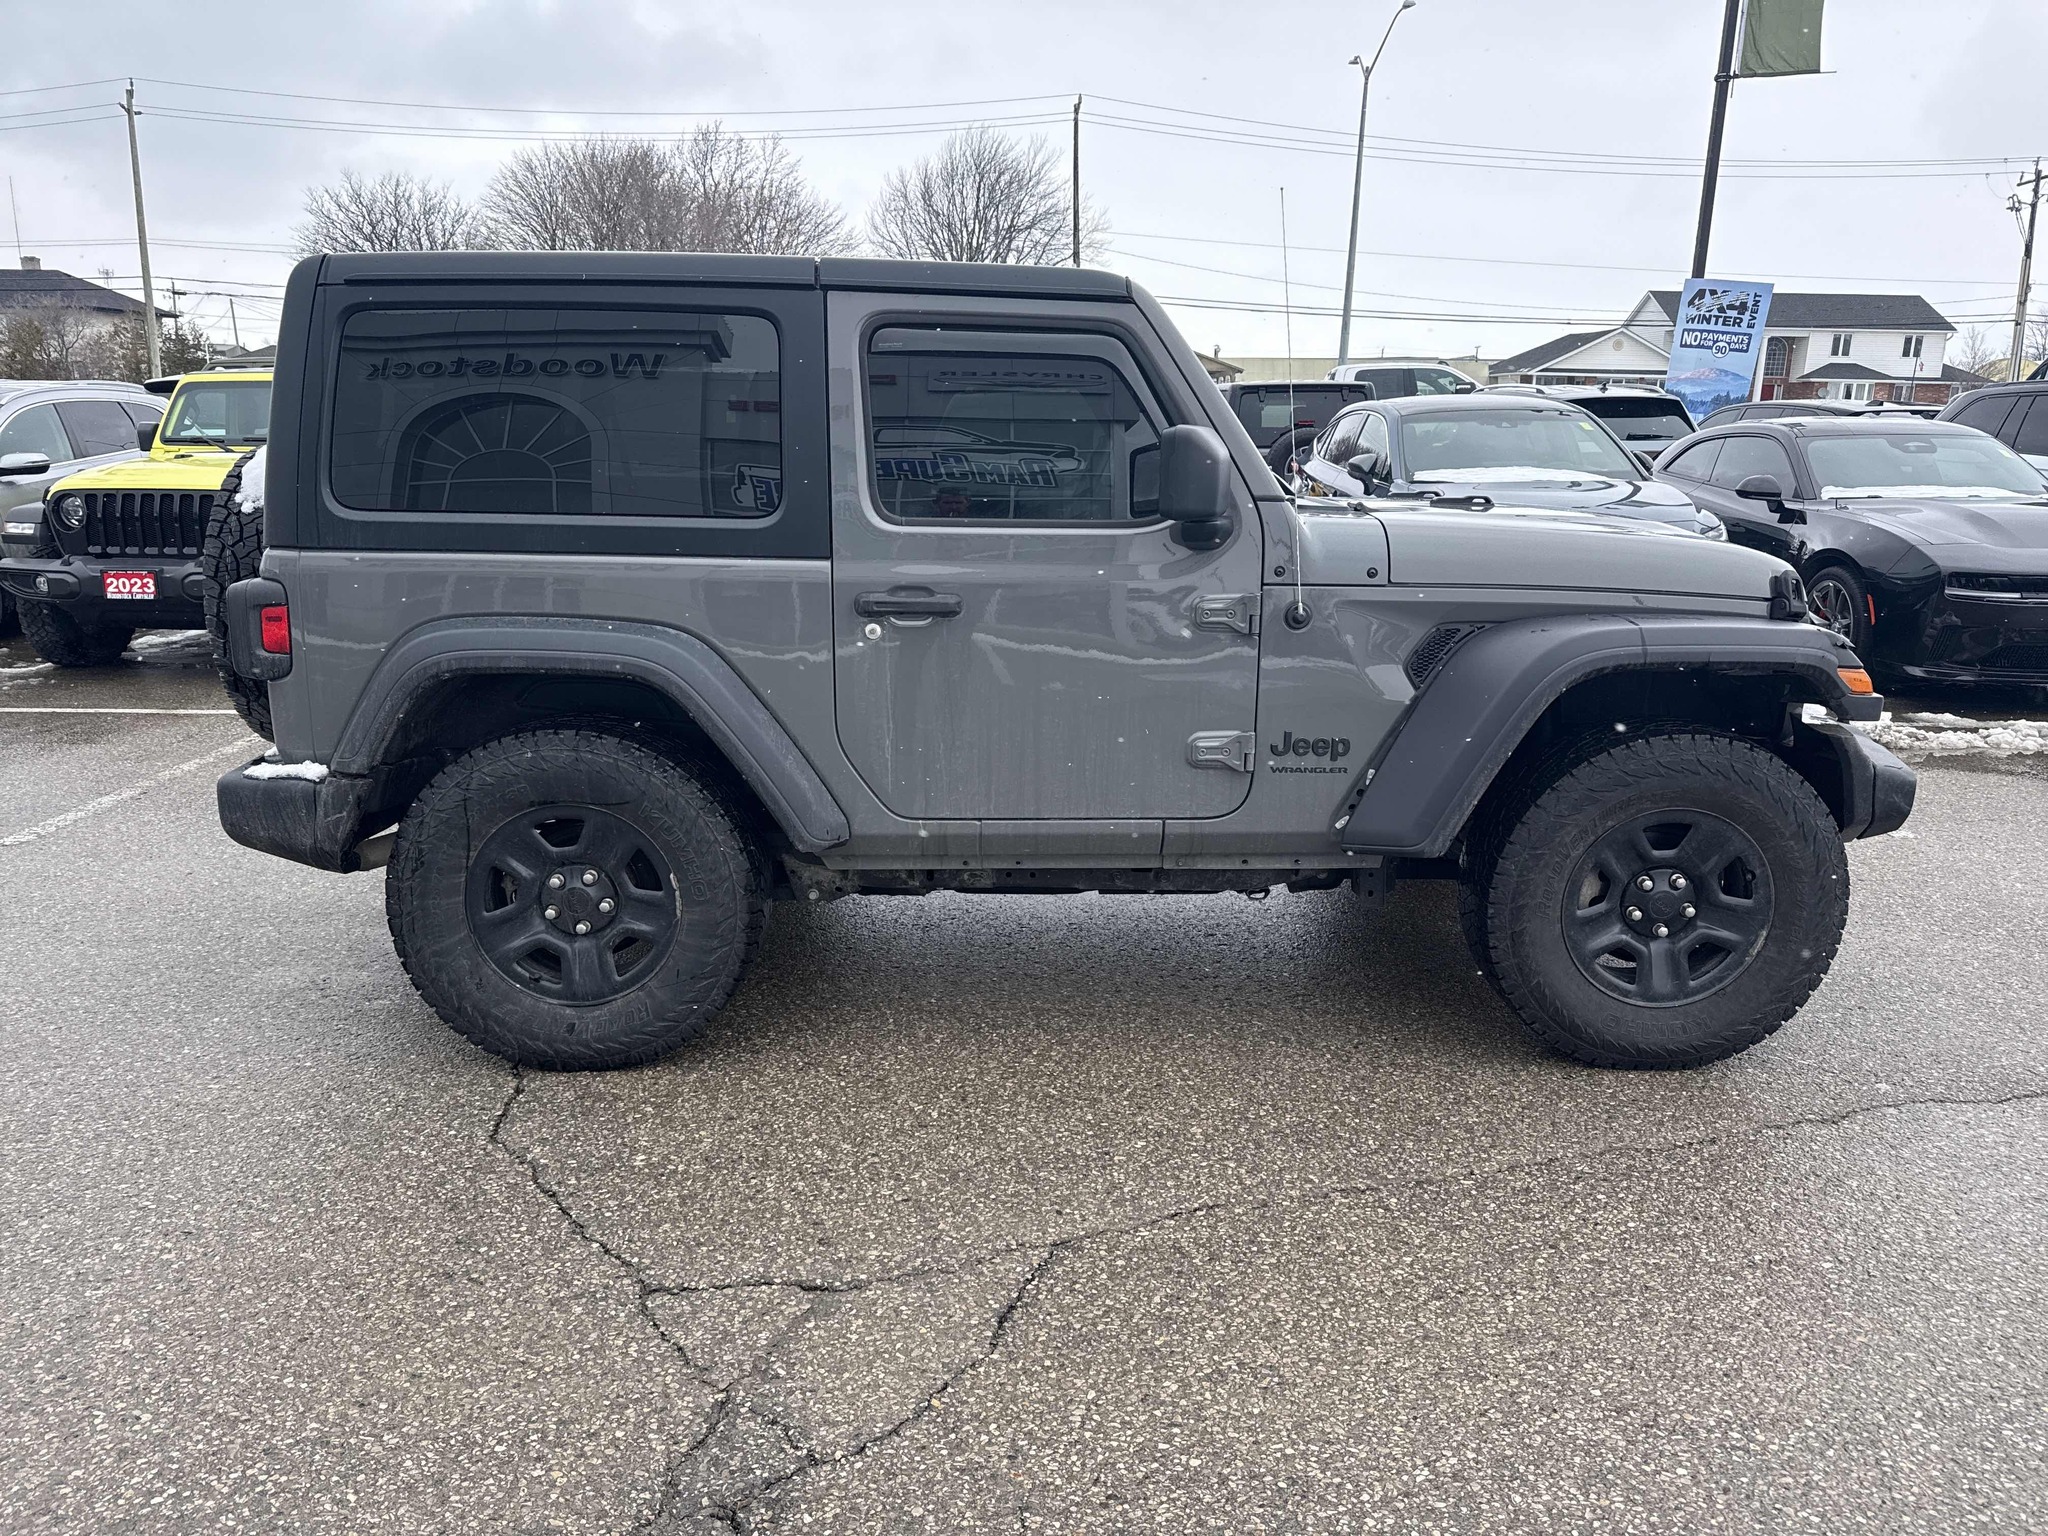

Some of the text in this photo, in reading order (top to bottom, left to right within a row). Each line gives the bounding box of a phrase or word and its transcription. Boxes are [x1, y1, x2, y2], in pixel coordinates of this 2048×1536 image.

[1687, 288, 1750, 316] 4X4
[1746, 292, 1762, 329] EVENT
[1685, 313, 1744, 328] WINTER
[1682, 331, 1701, 346] NO
[1701, 332, 1749, 344] PAYMENTS
[1713, 344, 1727, 355] 90
[106, 577, 155, 593] 2023
[1270, 730, 1351, 762] Jeep
[1270, 766, 1348, 774] WRANGLER
